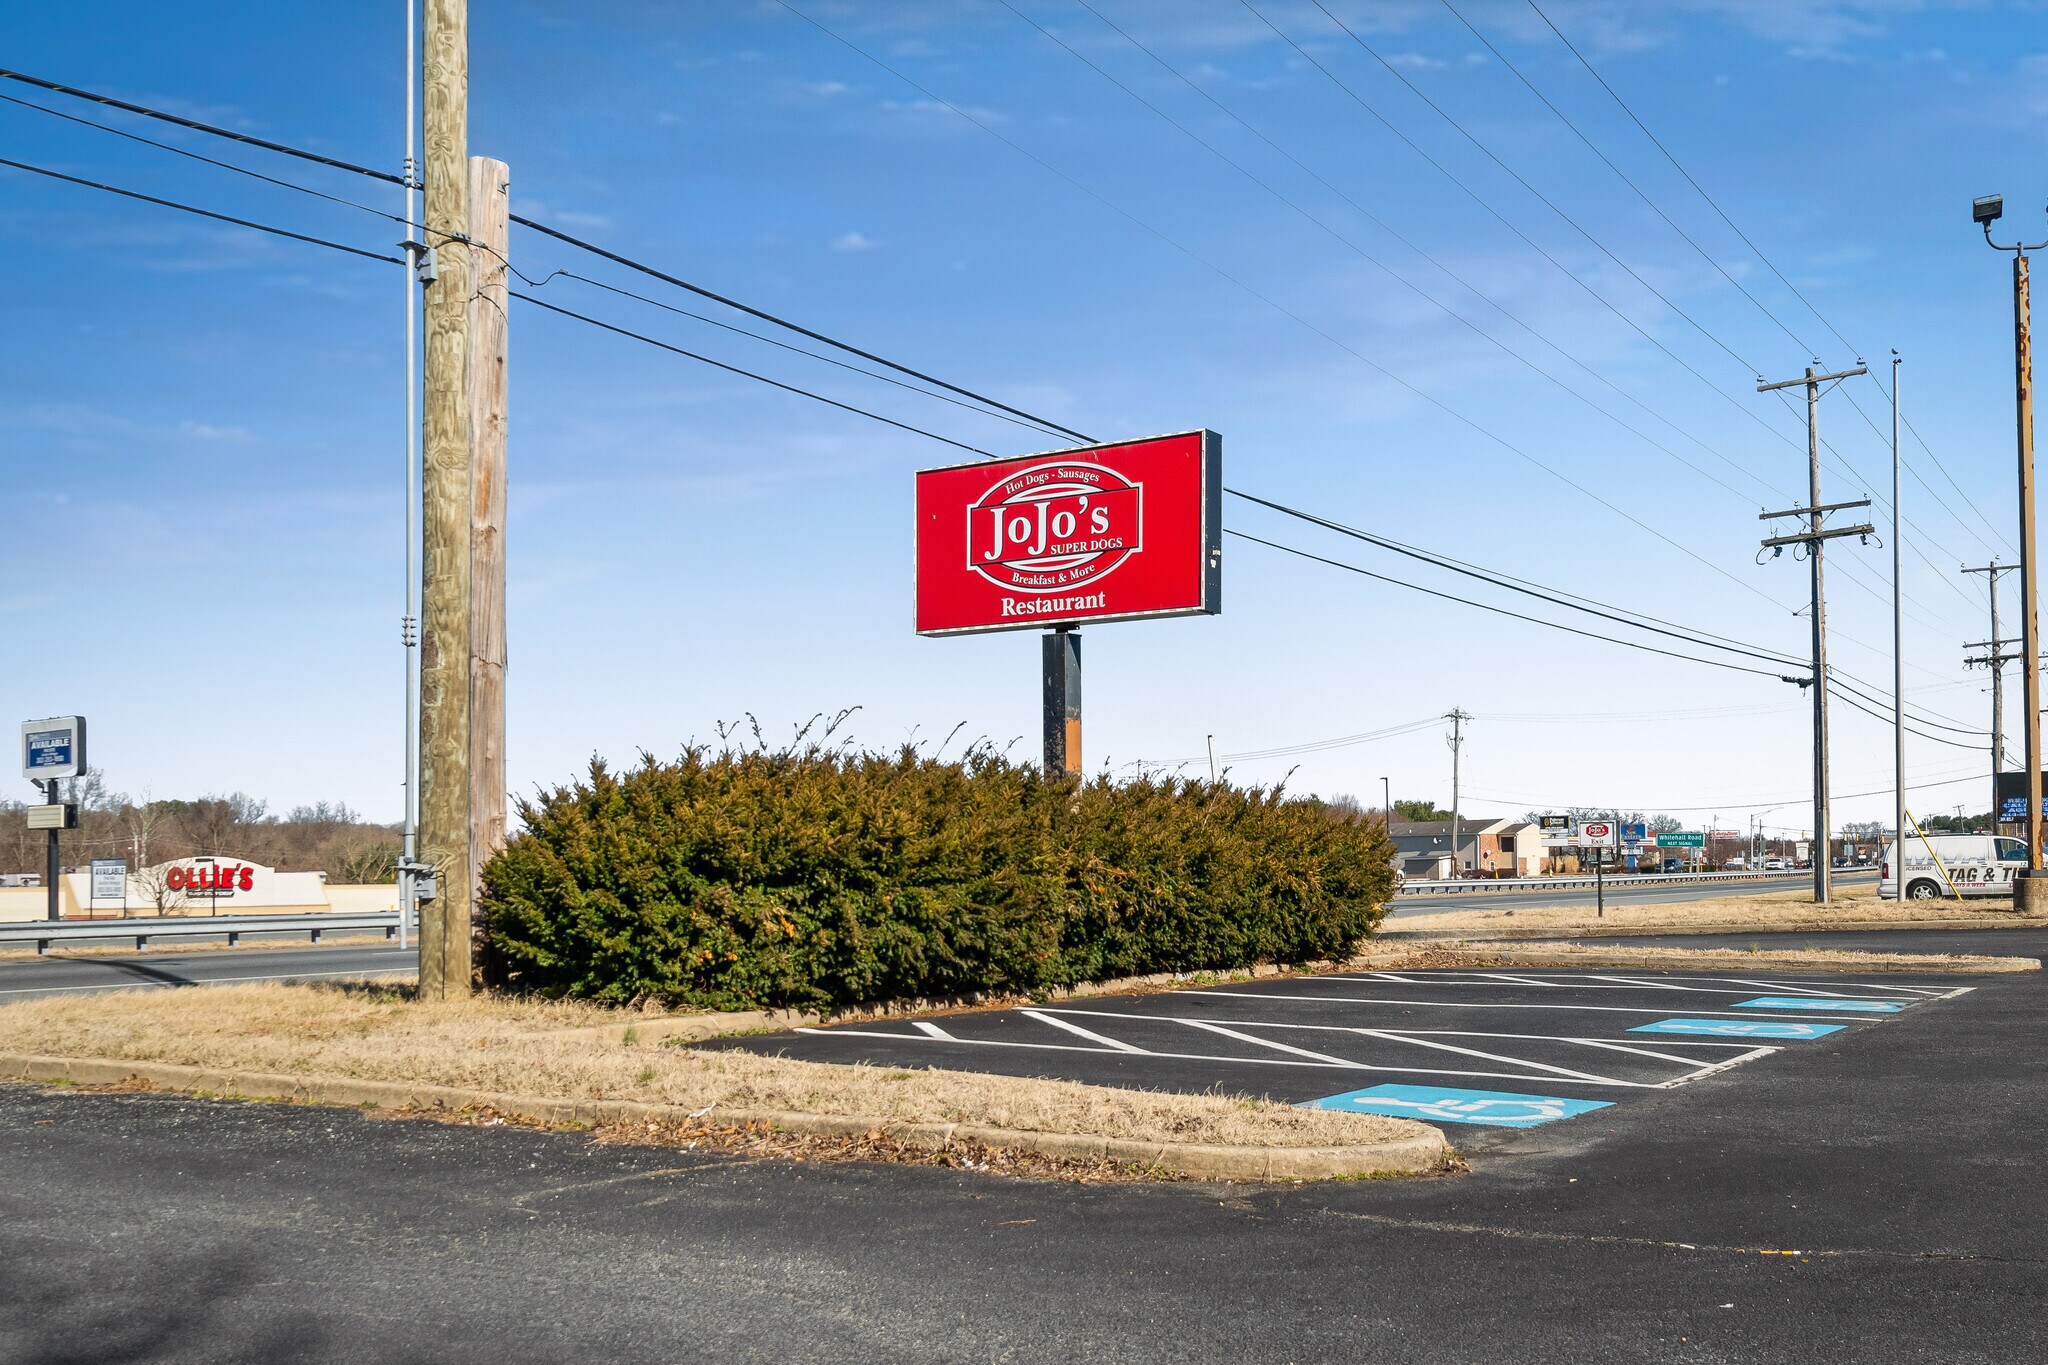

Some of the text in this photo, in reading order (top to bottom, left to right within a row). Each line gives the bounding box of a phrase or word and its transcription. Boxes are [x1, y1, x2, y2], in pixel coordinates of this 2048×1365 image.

[1005, 480, 1024, 495] Hot
[1026, 473, 1049, 484] Dogs
[1057, 468, 1100, 482] Sausages
[984, 495, 1110, 561] JoJo's
[1050, 537, 1123, 555] SUPER DOGS
[1012, 564, 1095, 585] Breakfast & More
[1001, 591, 1106, 617] Restaurant
[31, 738, 70, 749] AVAILABLE
[96, 867, 125, 875] AVAILABLE
[1947, 867, 1978, 882] TAG
[1983, 867, 1995, 882] &
